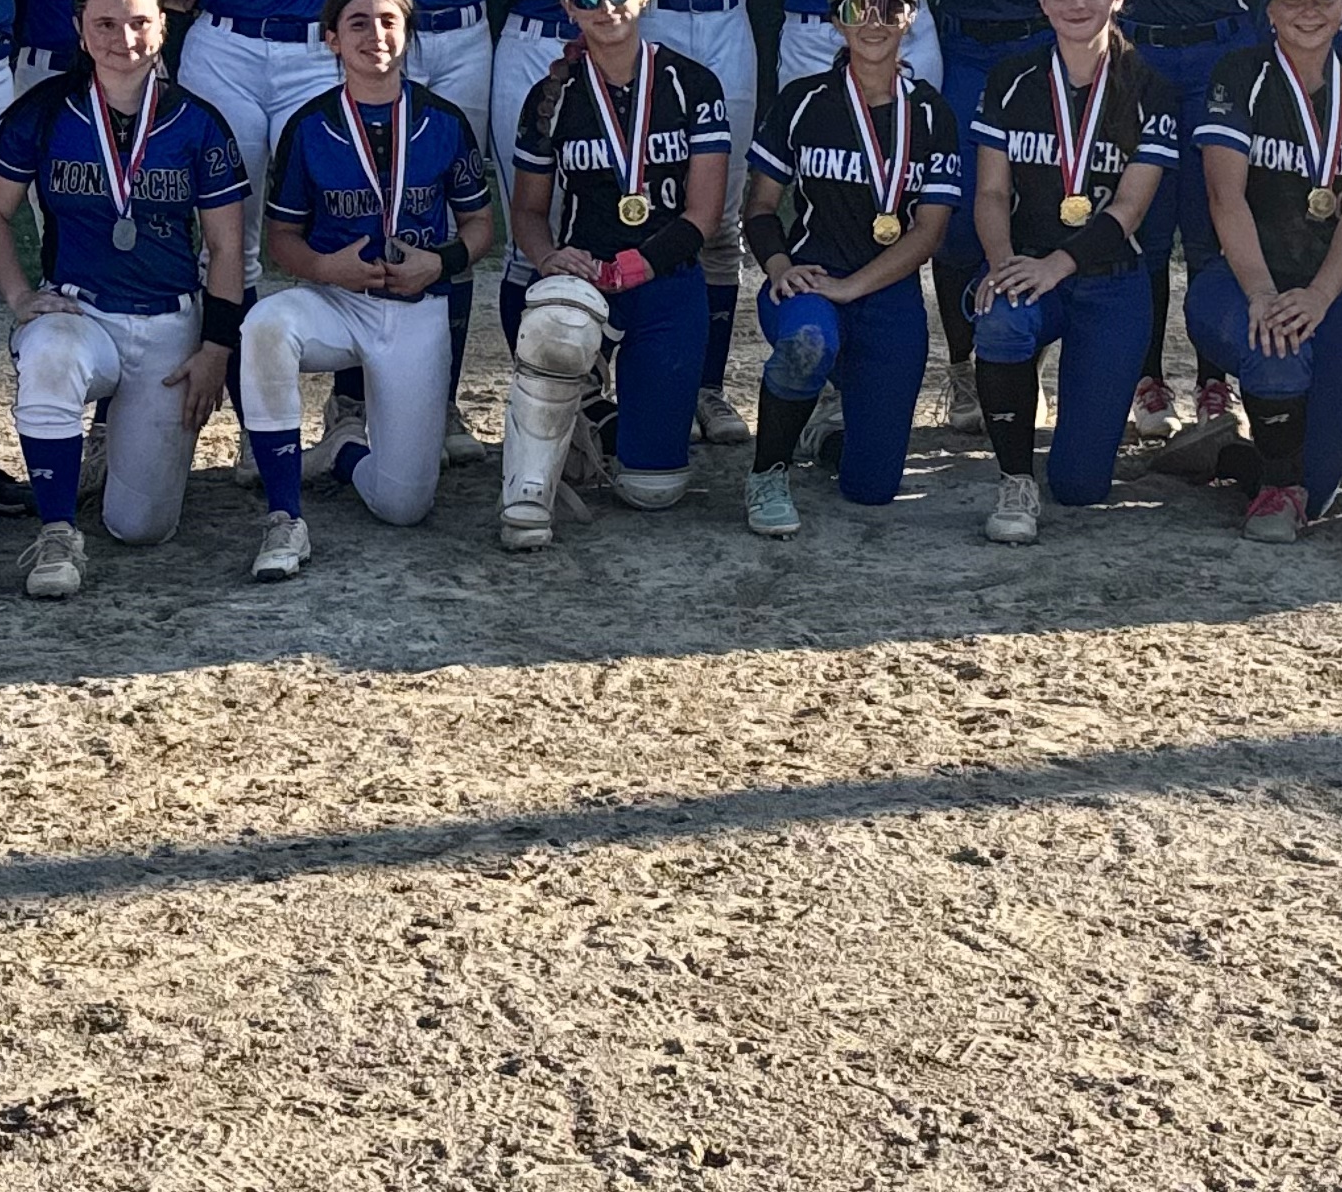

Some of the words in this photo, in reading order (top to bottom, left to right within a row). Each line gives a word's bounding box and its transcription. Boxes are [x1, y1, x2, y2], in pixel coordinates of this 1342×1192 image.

[696, 99, 730, 125] 20
[562, 128, 689, 171] MONCHS
[799, 144, 925, 193] MONAHS
[1007, 129, 1130, 175] MONCH
[48, 159, 192, 202] MONRCHS
